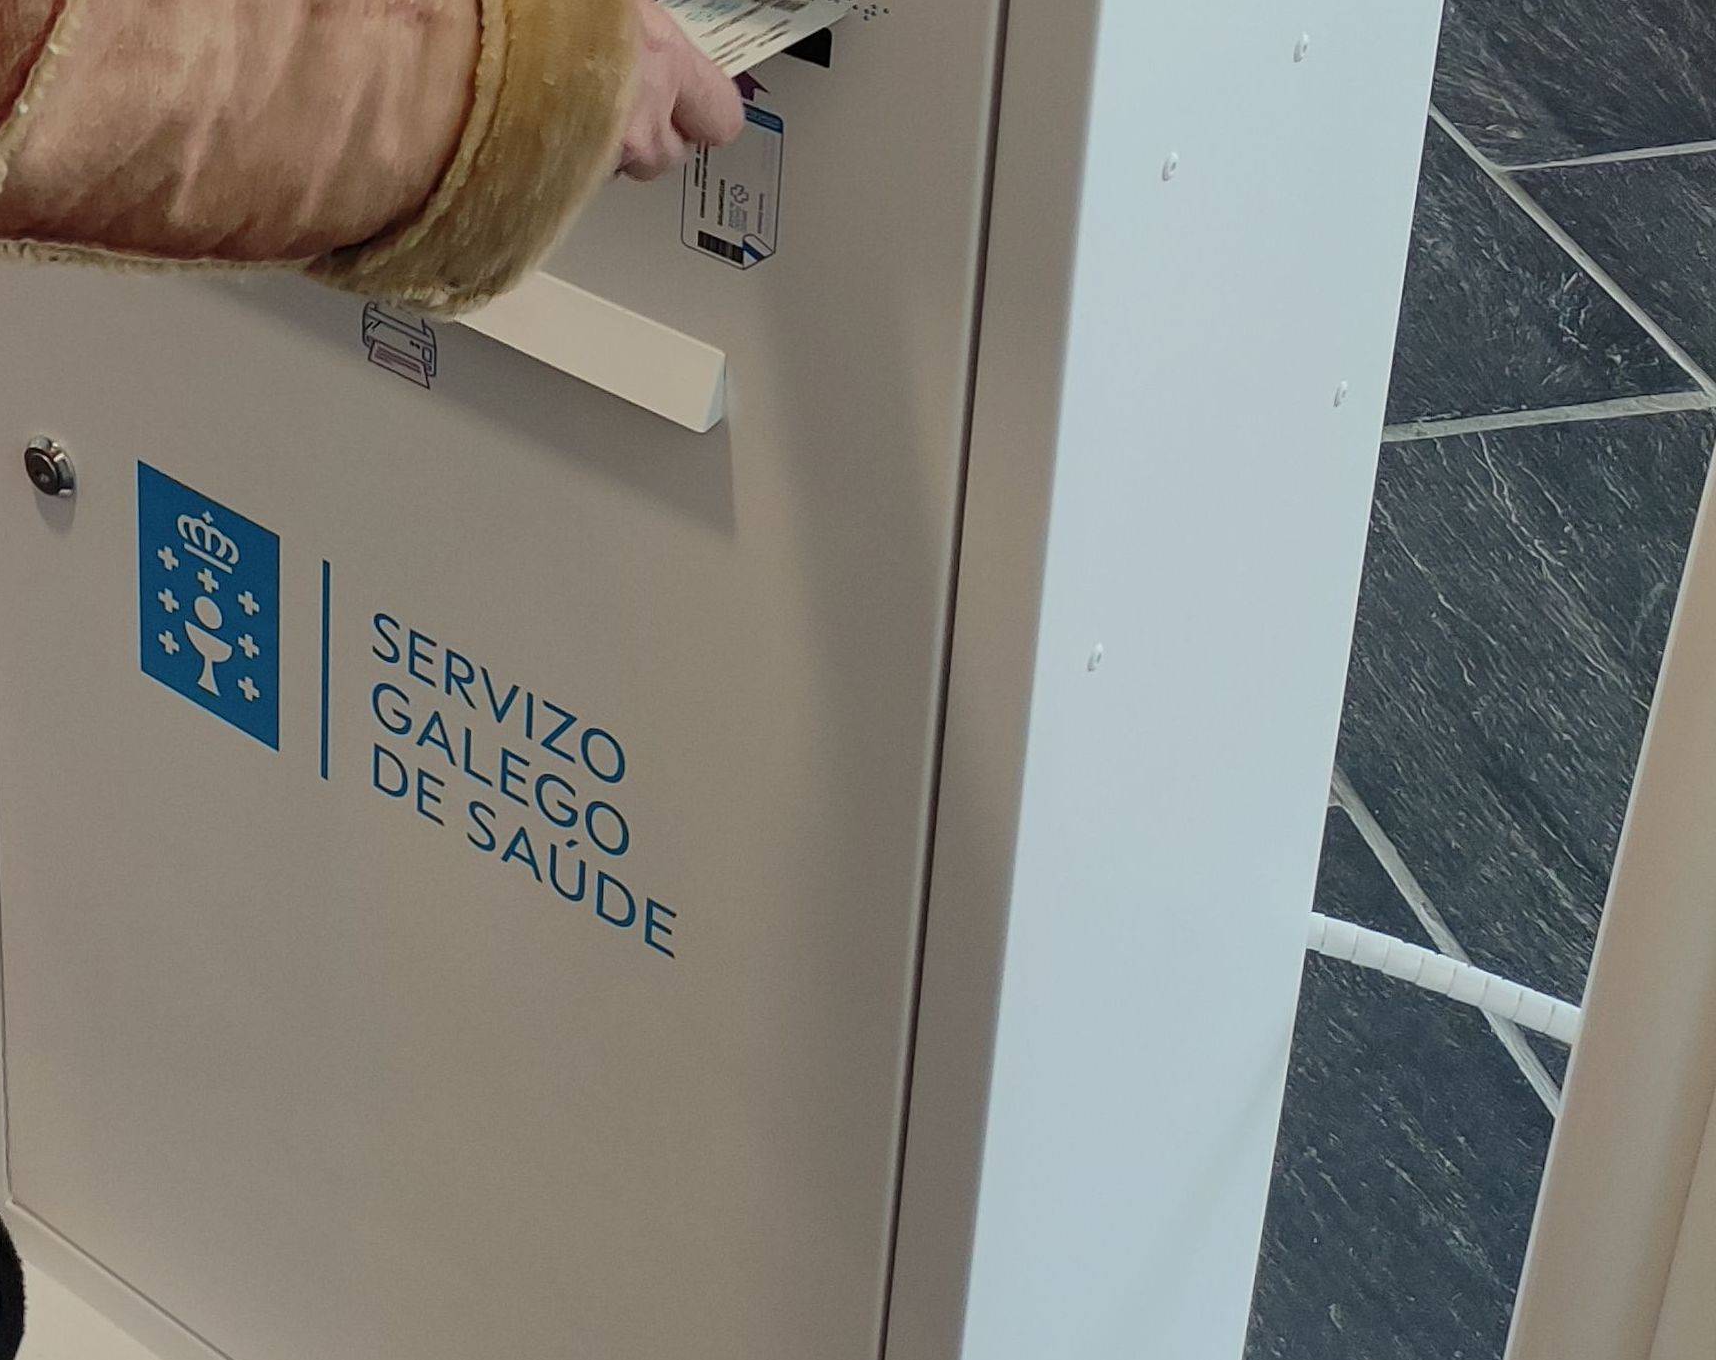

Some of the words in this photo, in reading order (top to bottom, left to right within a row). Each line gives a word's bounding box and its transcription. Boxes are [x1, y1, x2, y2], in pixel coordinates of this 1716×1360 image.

[371, 612, 628, 784] SERVIZO
[371, 682, 631, 857] GALEGO
[373, 742, 447, 827] DE
[466, 801, 678, 959] SAÚDE
